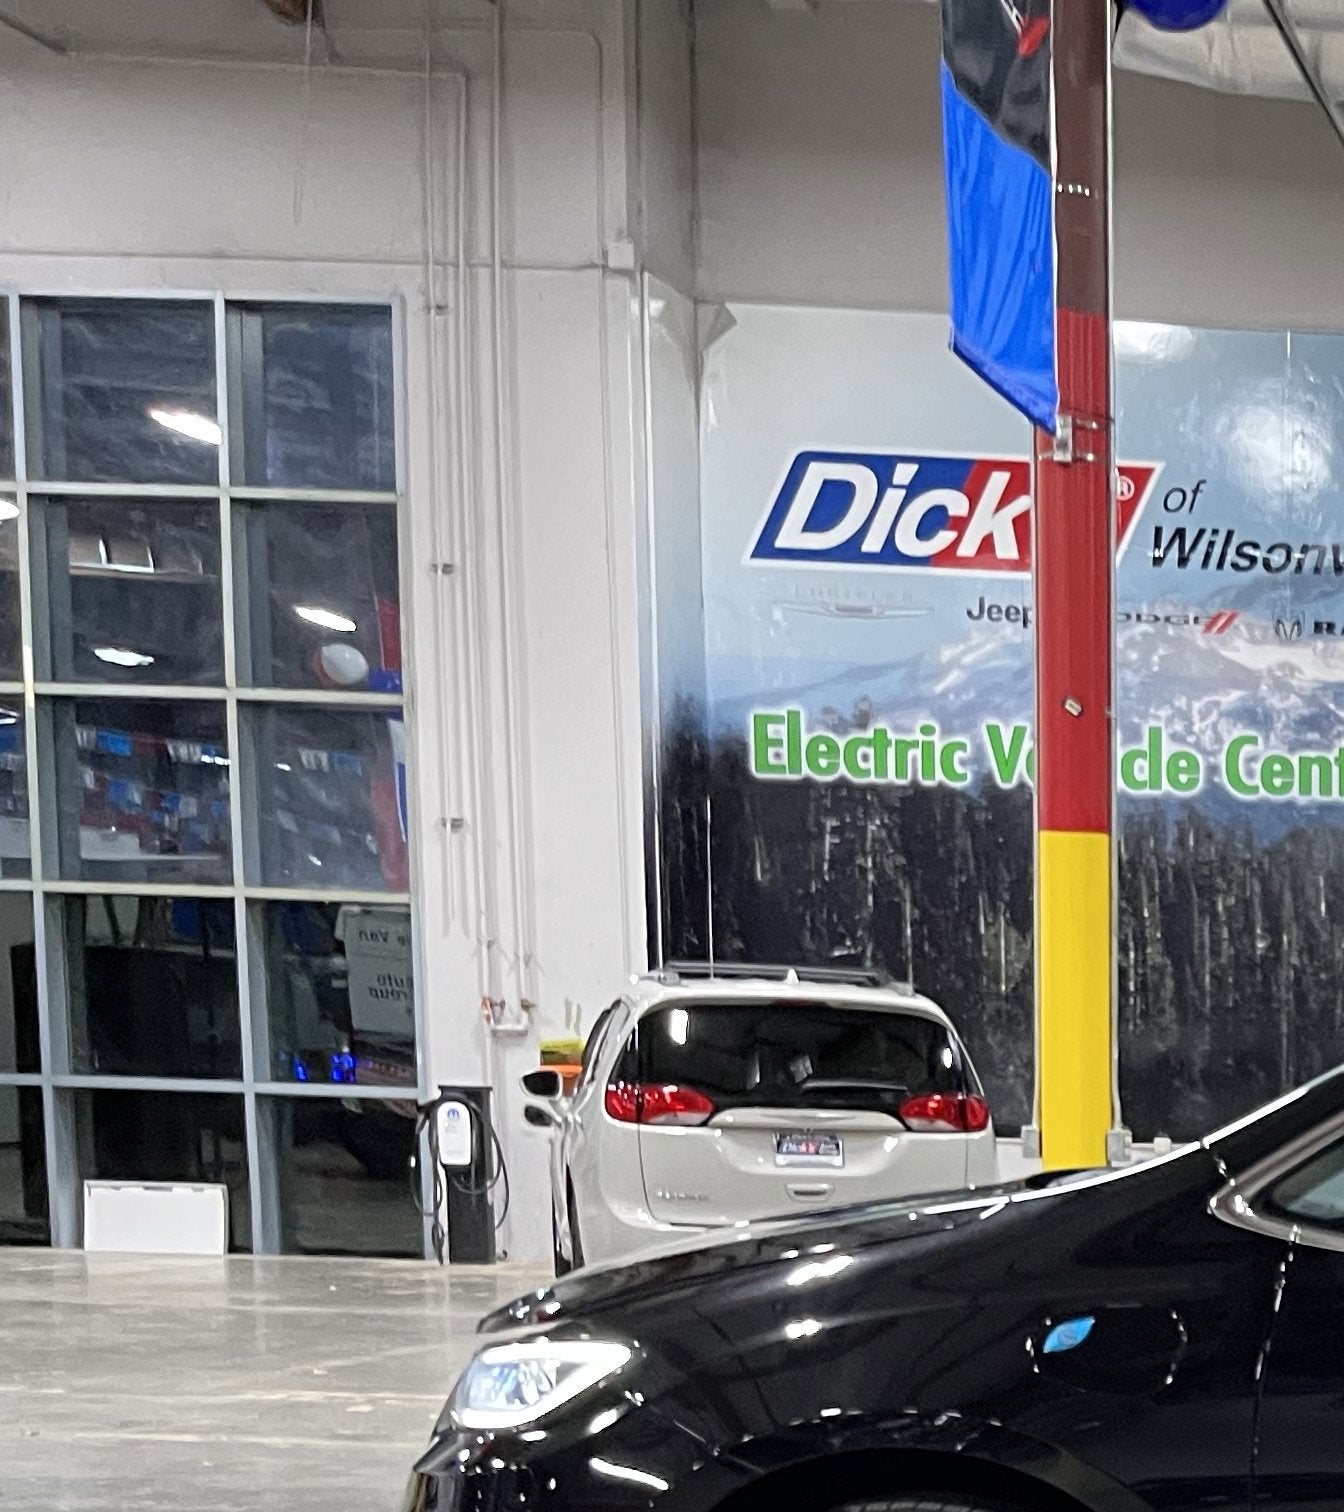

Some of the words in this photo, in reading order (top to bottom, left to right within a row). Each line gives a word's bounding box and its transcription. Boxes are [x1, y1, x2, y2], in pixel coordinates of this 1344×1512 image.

[774, 461, 1031, 560] Dick
[1163, 479, 1207, 513] of
[753, 710, 968, 783] Electric
[986, 723, 1200, 792] Vcle
